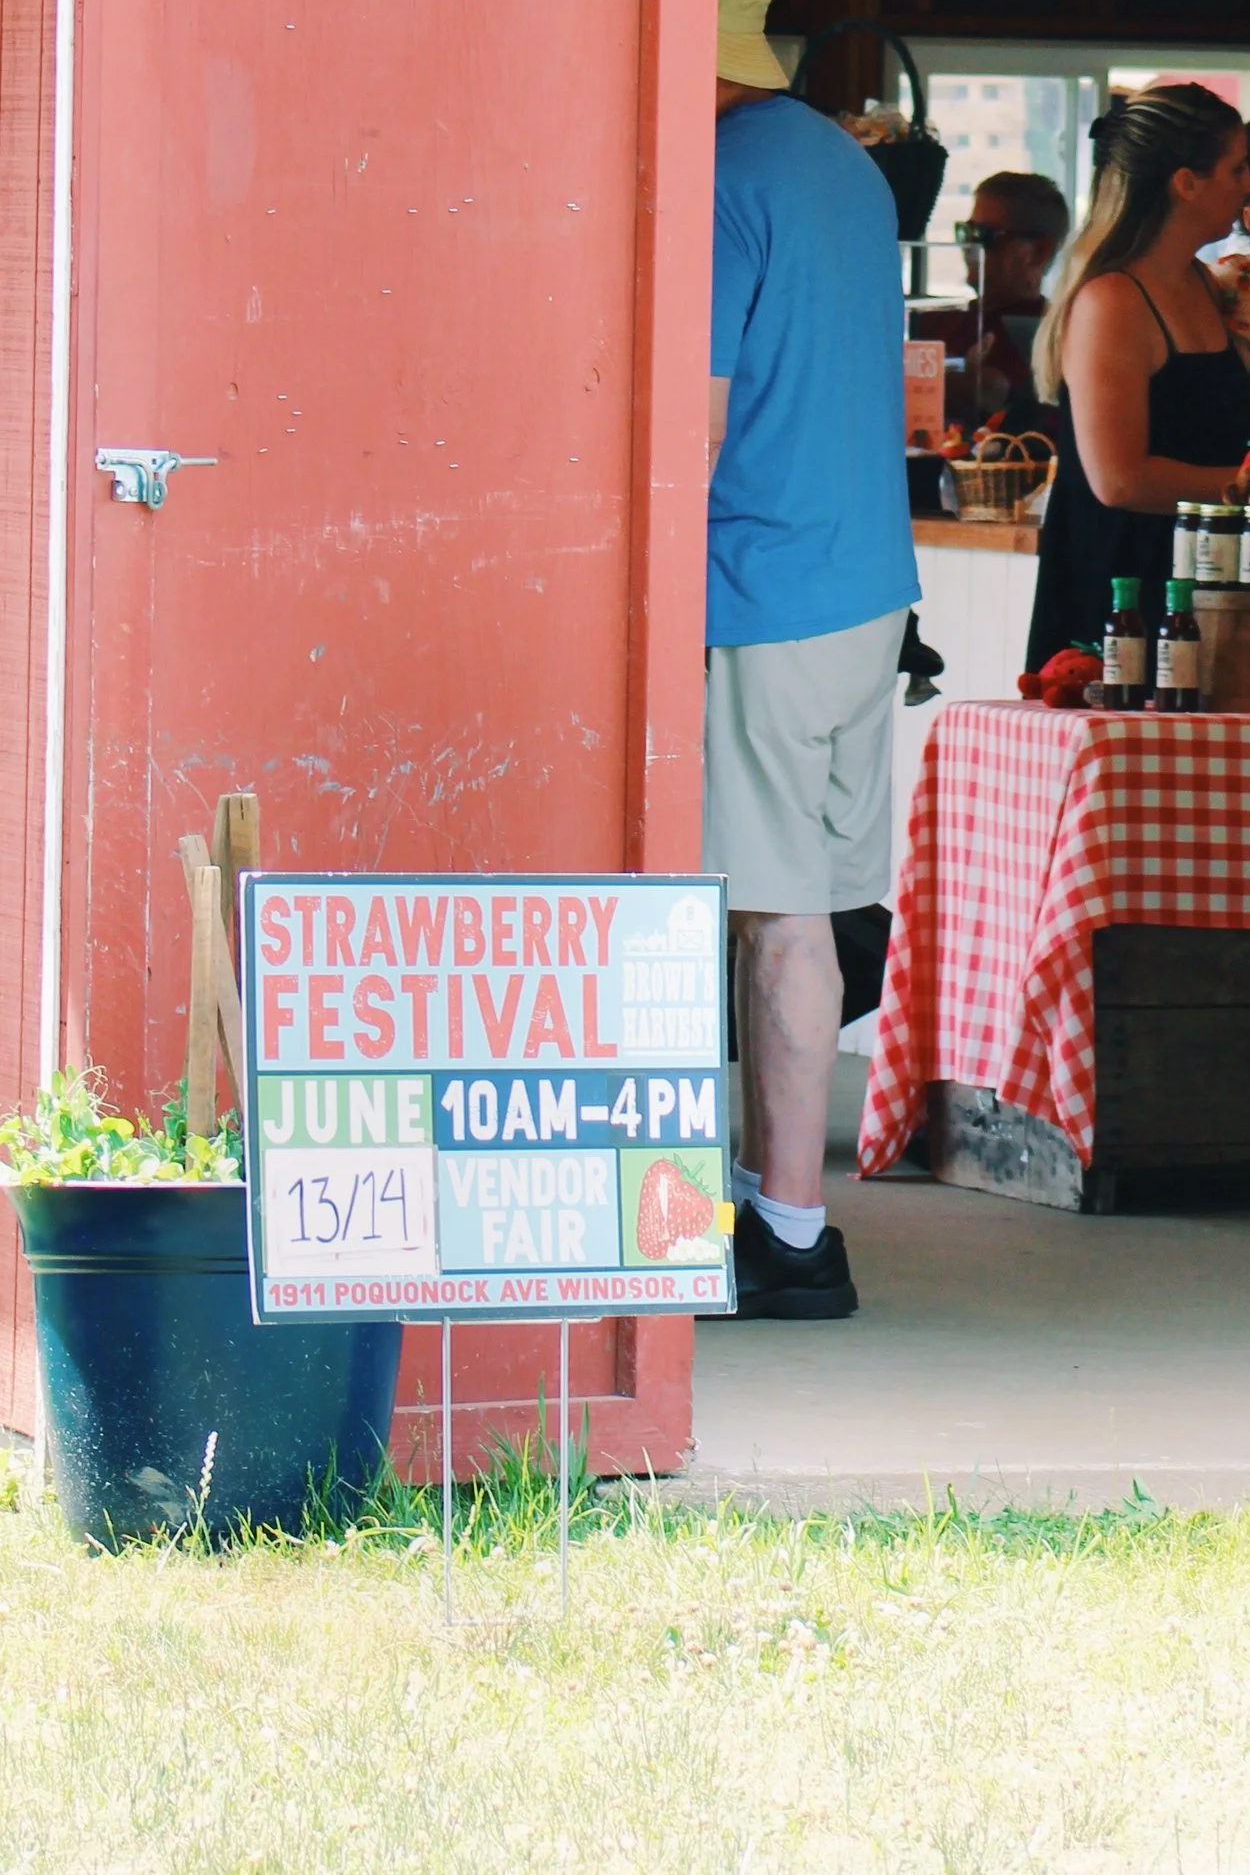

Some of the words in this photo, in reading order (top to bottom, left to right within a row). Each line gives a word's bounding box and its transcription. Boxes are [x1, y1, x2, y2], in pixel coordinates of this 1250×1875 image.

[260, 895, 619, 968] STRAWBERRY
[622, 959, 716, 1003] BROWN'S
[263, 974, 619, 1060] FESTIVAL
[621, 1007, 716, 1048] HARVEST
[263, 1079, 426, 1144] JUNE
[288, 1167, 409, 1245] 13/14
[446, 1156, 608, 1208] VENDOR
[482, 1210, 586, 1264] FAIR
[268, 1283, 326, 1307] 1911
[335, 1280, 489, 1306] POQUONOCK
[500, 1278, 548, 1302] AVE
[559, 1276, 684, 1303] WINDSOR,
[692, 1274, 720, 1299] CT
